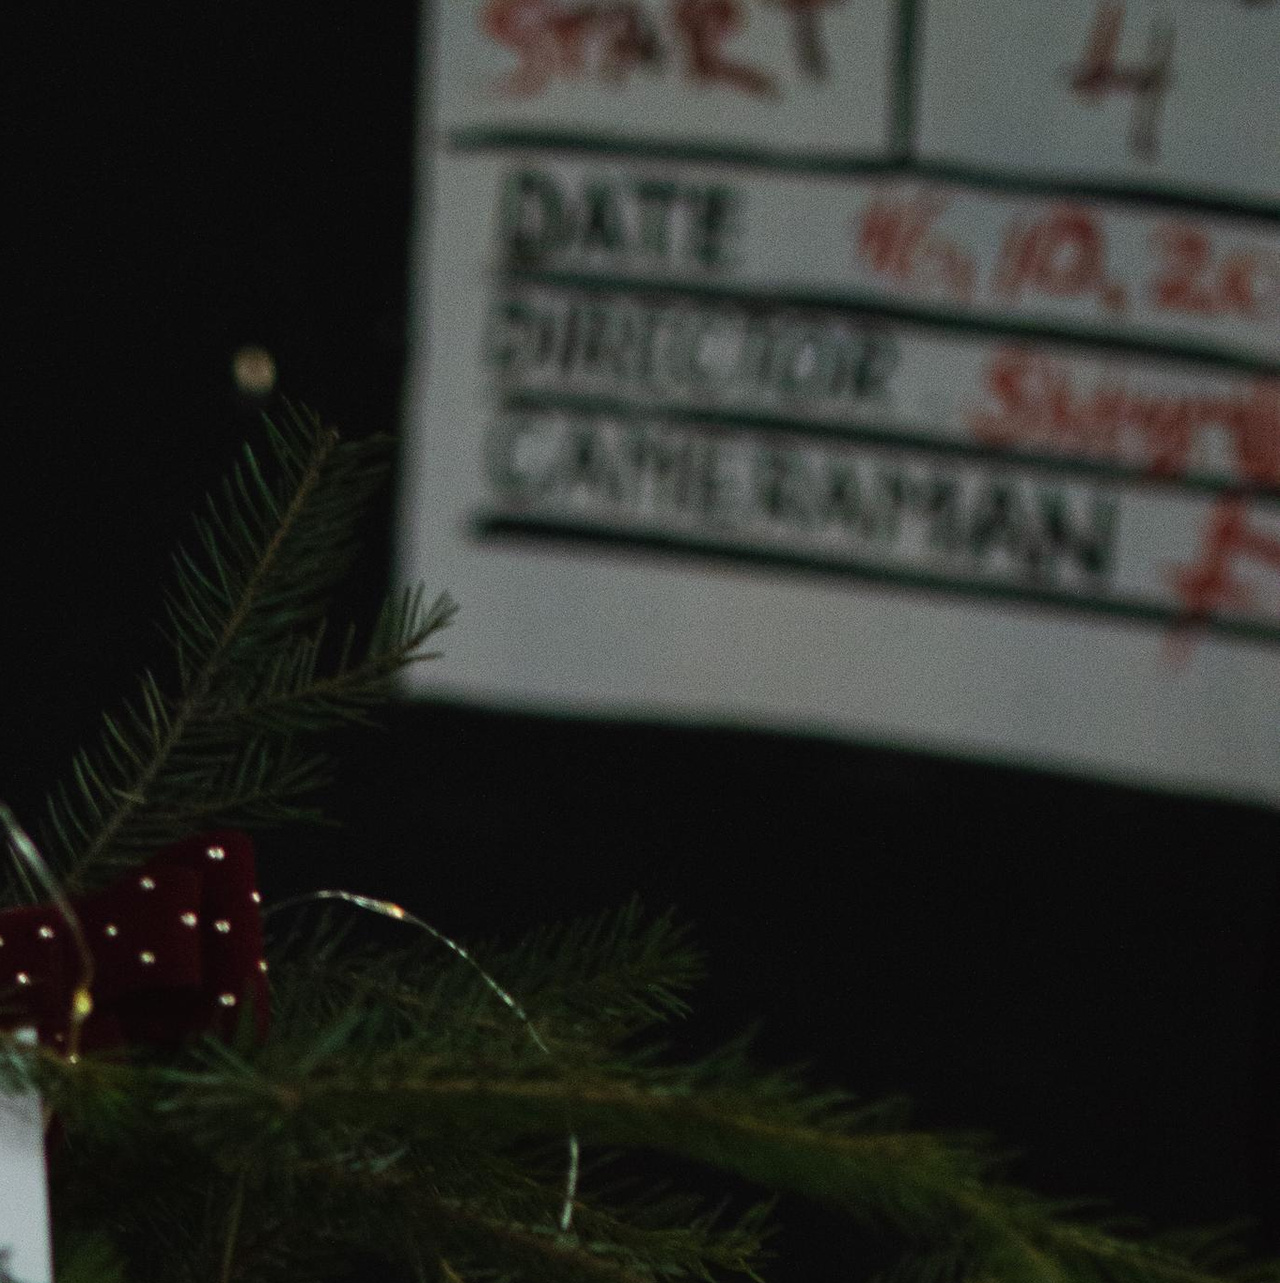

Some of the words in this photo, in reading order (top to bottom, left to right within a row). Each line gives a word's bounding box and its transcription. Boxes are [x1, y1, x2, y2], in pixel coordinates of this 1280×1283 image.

[496, 165, 742, 272] DATE
[486, 297, 902, 402] DIRECTOR
[482, 410, 1120, 583] CAMERAMAN
